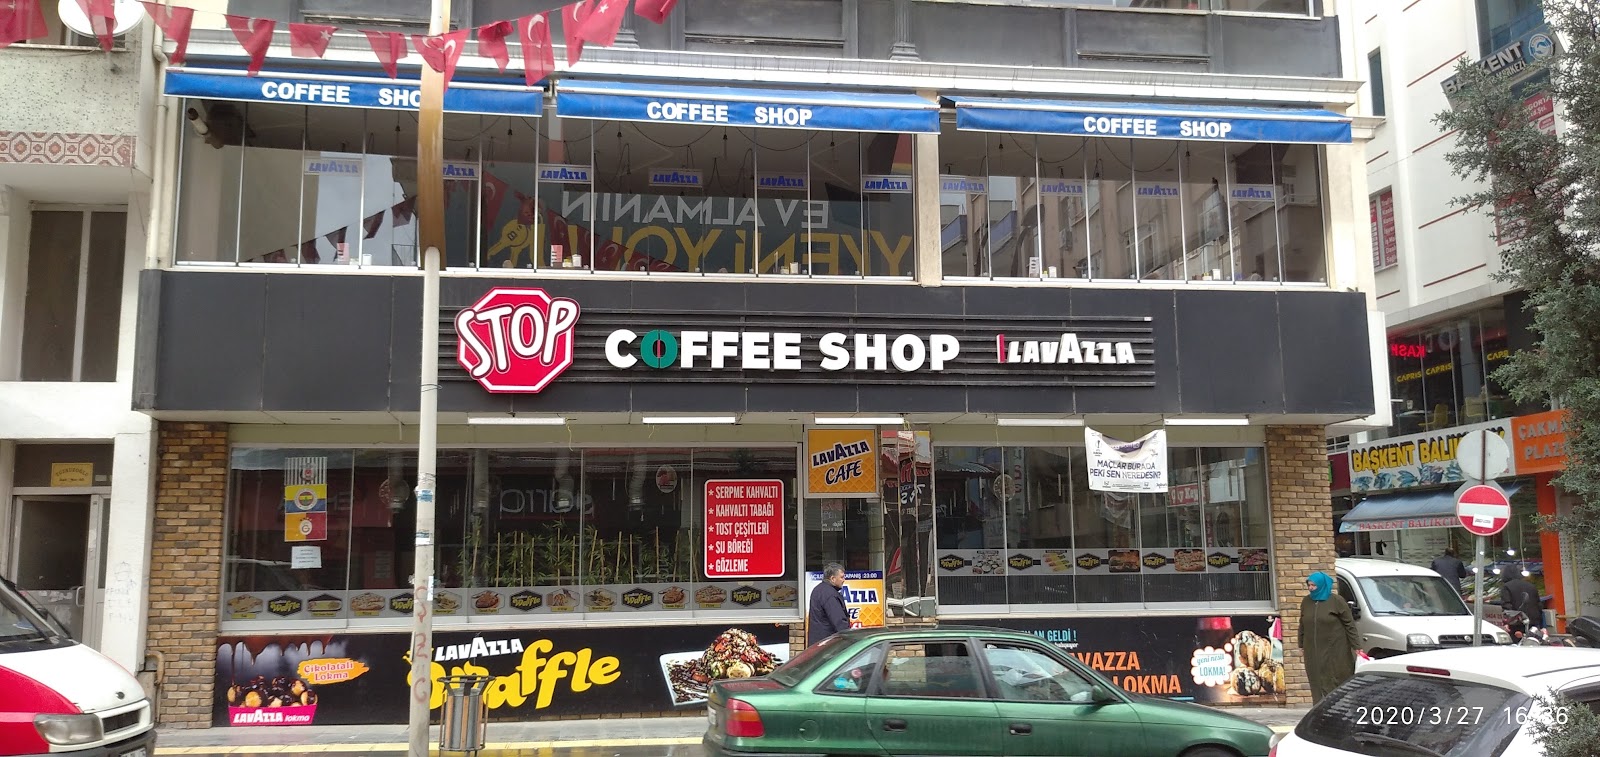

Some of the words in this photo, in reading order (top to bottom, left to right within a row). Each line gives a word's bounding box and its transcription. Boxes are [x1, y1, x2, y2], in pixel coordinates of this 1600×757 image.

[261, 81, 350, 103] COFFEE
[378, 88, 421, 107] SHO
[647, 101, 728, 122] COFFEE
[754, 106, 812, 126] SHOP
[1083, 116, 1157, 136] COFFEE
[1180, 120, 1231, 138] SHOP
[443, 164, 475, 177] AZZA
[541, 167, 588, 180] LAVAZZA
[653, 171, 698, 184] LAVAZZA
[760, 176, 805, 188] LAVAZZA
[865, 177, 909, 190] LAVAZZA
[942, 179, 985, 192] LAVAZZA
[1041, 181, 1084, 194] LAVAZZA
[1137, 185, 1179, 196] LAVAZZA
[1231, 186, 1272, 199] LAVAZZA
[455, 297, 580, 380] STOP
[604, 328, 801, 371] COFFEE
[819, 331, 960, 372] SHOP
[1007, 332, 1135, 364] LAVAZZA
[812, 441, 870, 467] LAVAZZA
[1352, 441, 1415, 476] BAŞKENT
[1097, 460, 1126, 469] MAÇLAR
[825, 460, 862, 485] CAFE
[1106, 470, 1120, 478] SEN
[715, 486, 744, 499] SERPME
[746, 486, 778, 498] KAHVALTI
[715, 504, 748, 517] KAHVALTI
[749, 502, 774, 517] TABAĞI
[715, 522, 733, 535] TOST
[734, 520, 769, 537] ÇEŞİTLERİ
[715, 541, 726, 554] SU
[727, 538, 753, 554] BÖREĞİ
[715, 557, 748, 572] GÖZLEME
[842, 585, 877, 603] AZZA
[1047, 628, 1070, 641] GELDİ
[435, 636, 524, 661] LAVAZZA
[1068, 652, 1140, 671] VAZZA
[1197, 656, 1210, 666] yeni
[315, 672, 348, 682] Lokma
[1200, 667, 1226, 676] LOKMA!
[233, 709, 283, 723] LAVAZZA
[285, 714, 310, 722] lokma
